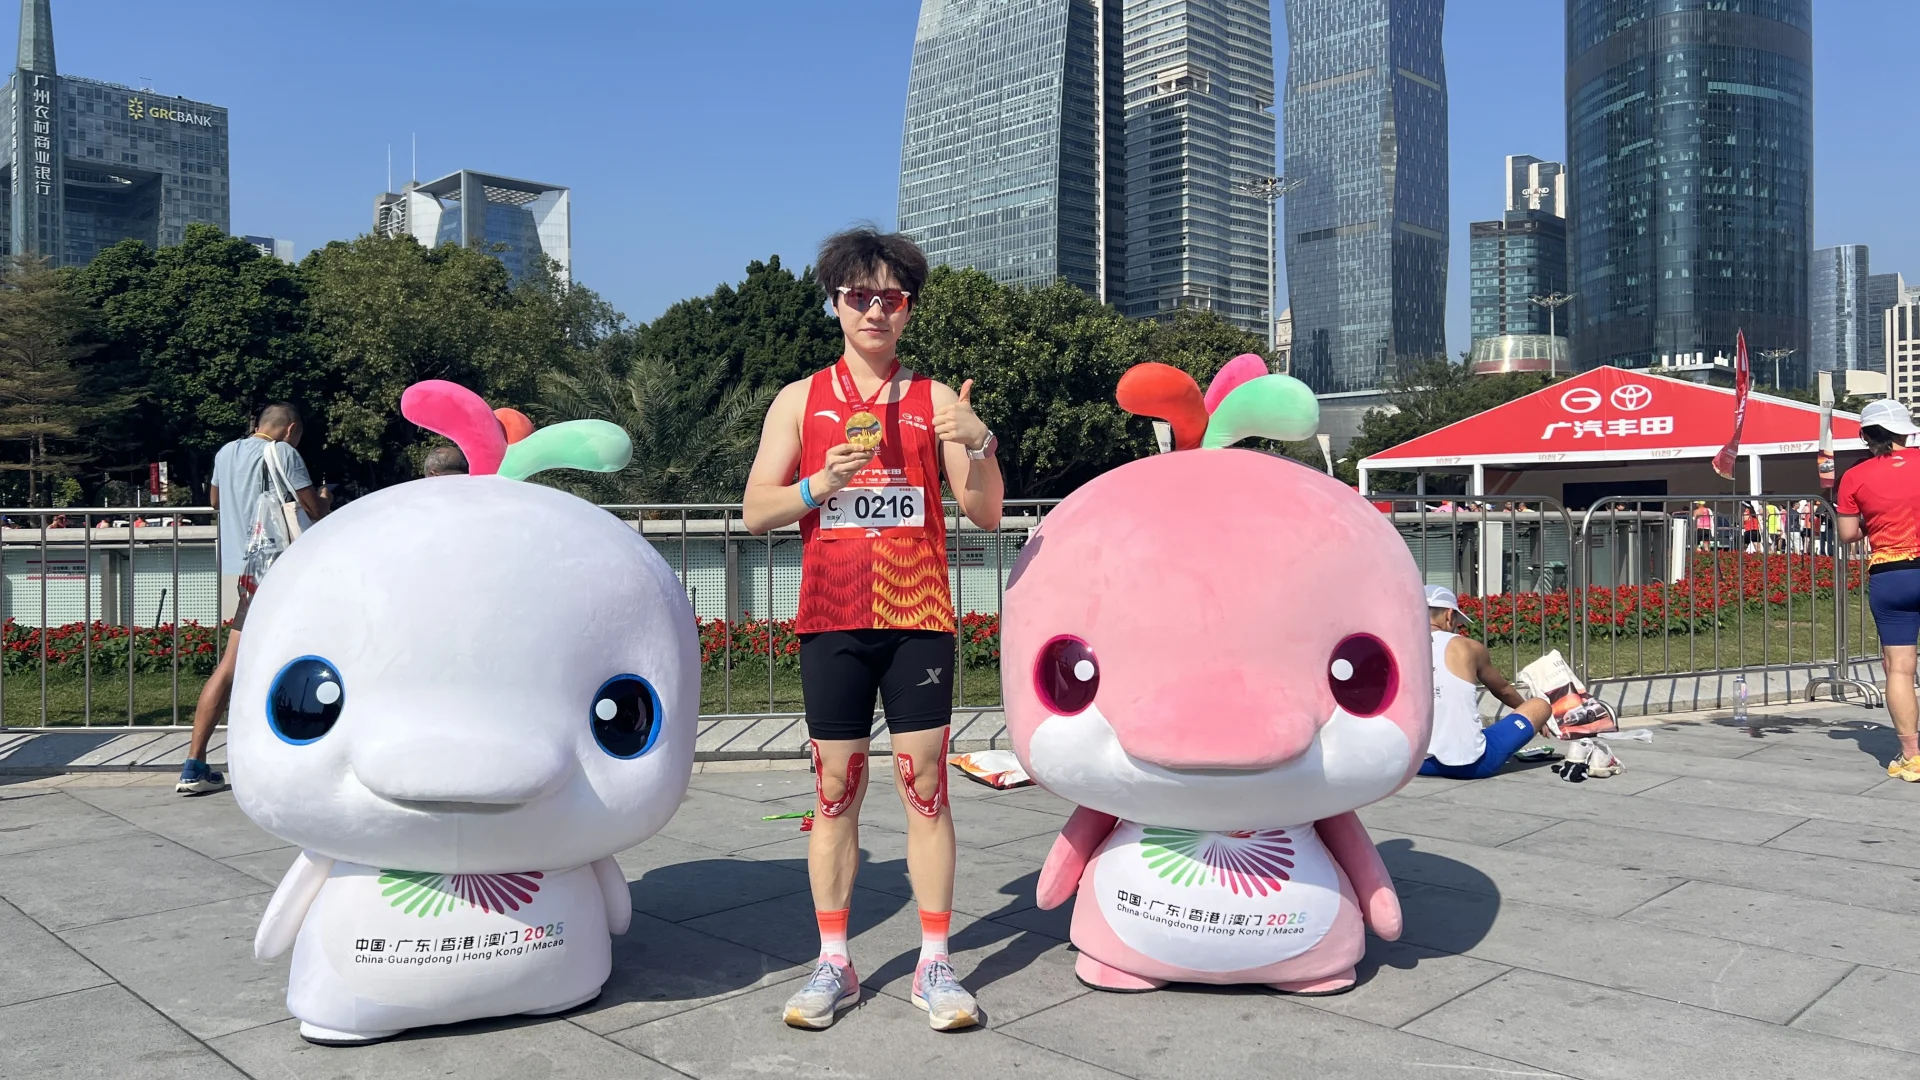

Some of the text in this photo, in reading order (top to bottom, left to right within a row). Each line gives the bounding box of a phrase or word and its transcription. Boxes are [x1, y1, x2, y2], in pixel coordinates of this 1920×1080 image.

[149, 107, 212, 127] GRCBANK
[33, 74, 51, 195] 广州农村商业银行
[1541, 416, 1674, 440] 广汽丰田
[828, 495, 914, 519] C 0216
[1266, 912, 1307, 926] 2025
[523, 921, 565, 942] 2025
[1207, 926, 1236, 936] Hong
[1238, 927, 1265, 936] Kong
[1273, 927, 1305, 935] Macao
[462, 951, 493, 961] Hong
[495, 946, 523, 957] Kong
[532, 939, 564, 952] Macao
